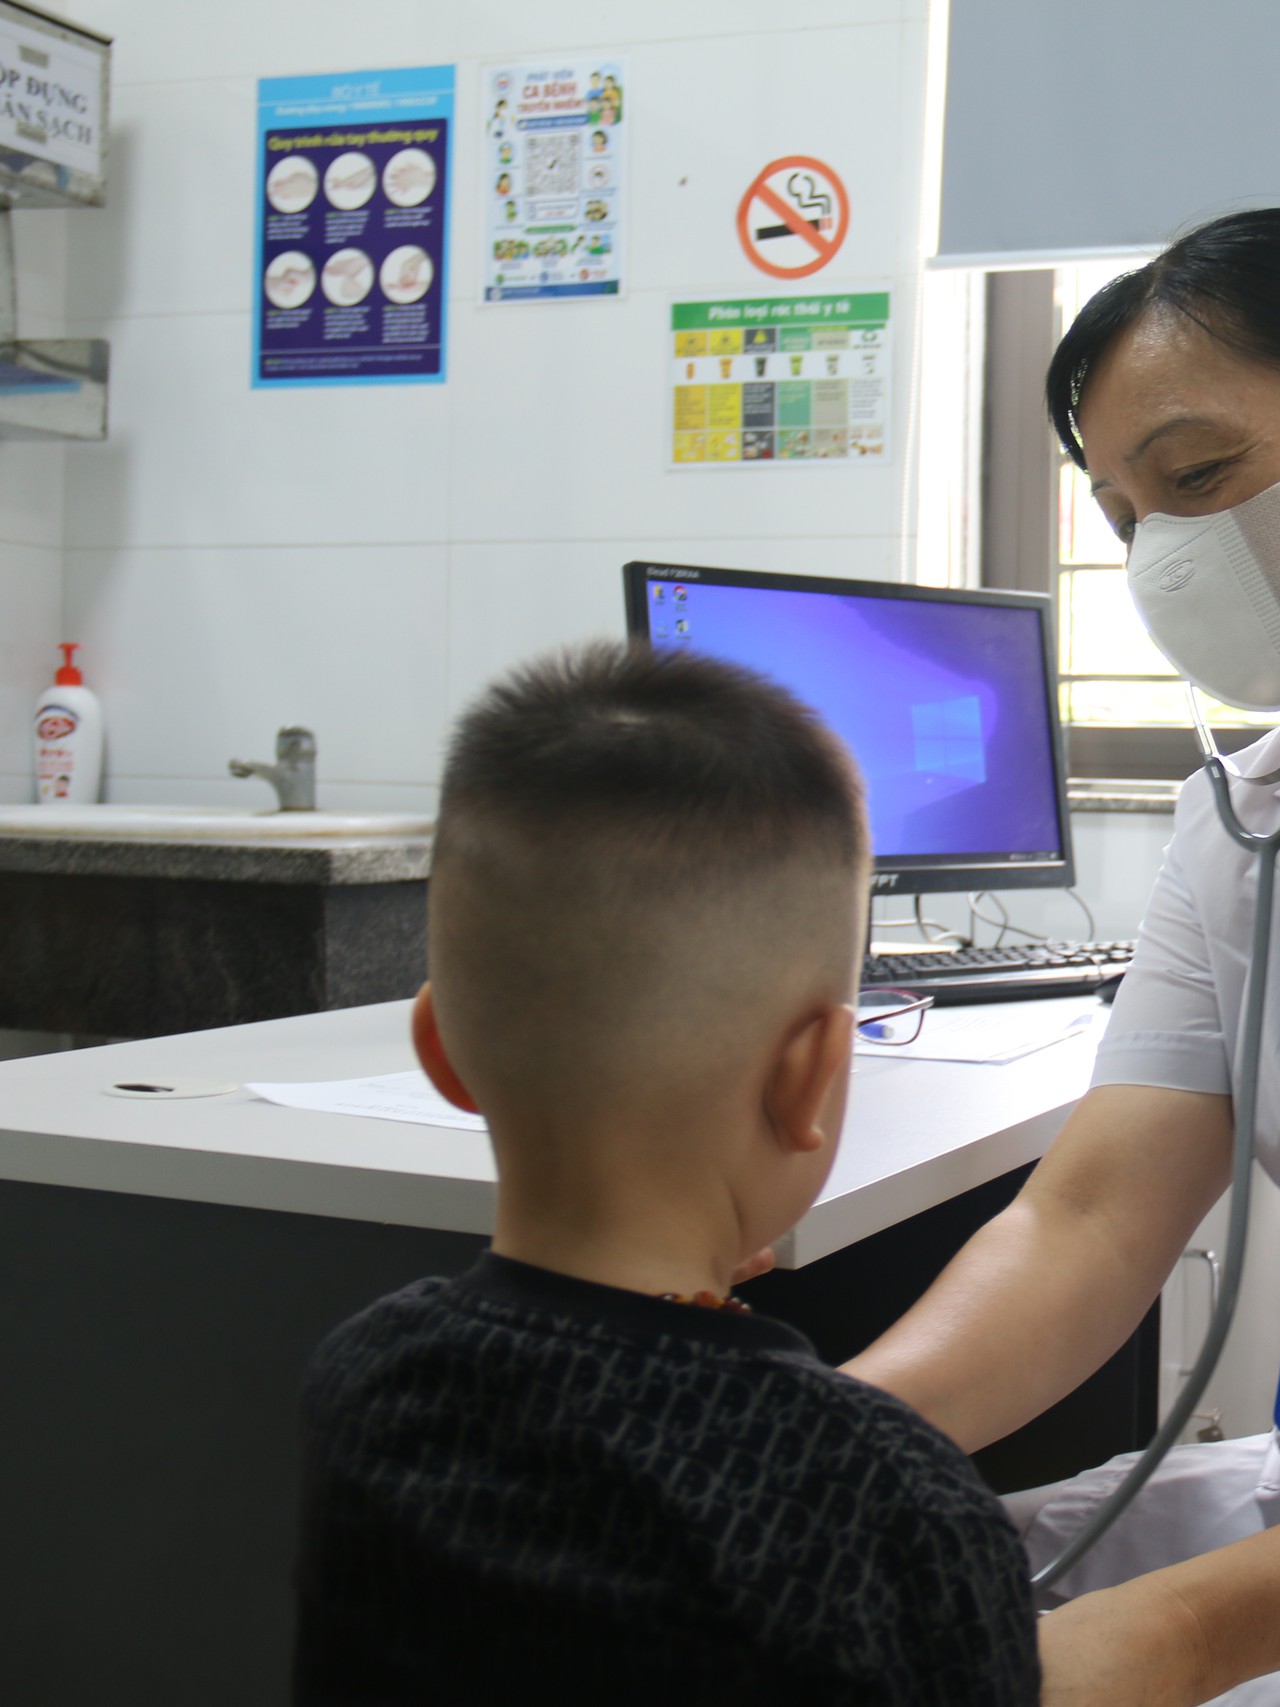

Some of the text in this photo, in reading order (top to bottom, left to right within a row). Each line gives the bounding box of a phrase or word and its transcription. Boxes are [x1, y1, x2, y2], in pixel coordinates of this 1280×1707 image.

[524, 81, 576, 98] CA BỆNH
[708, 305, 741, 320] Phân
